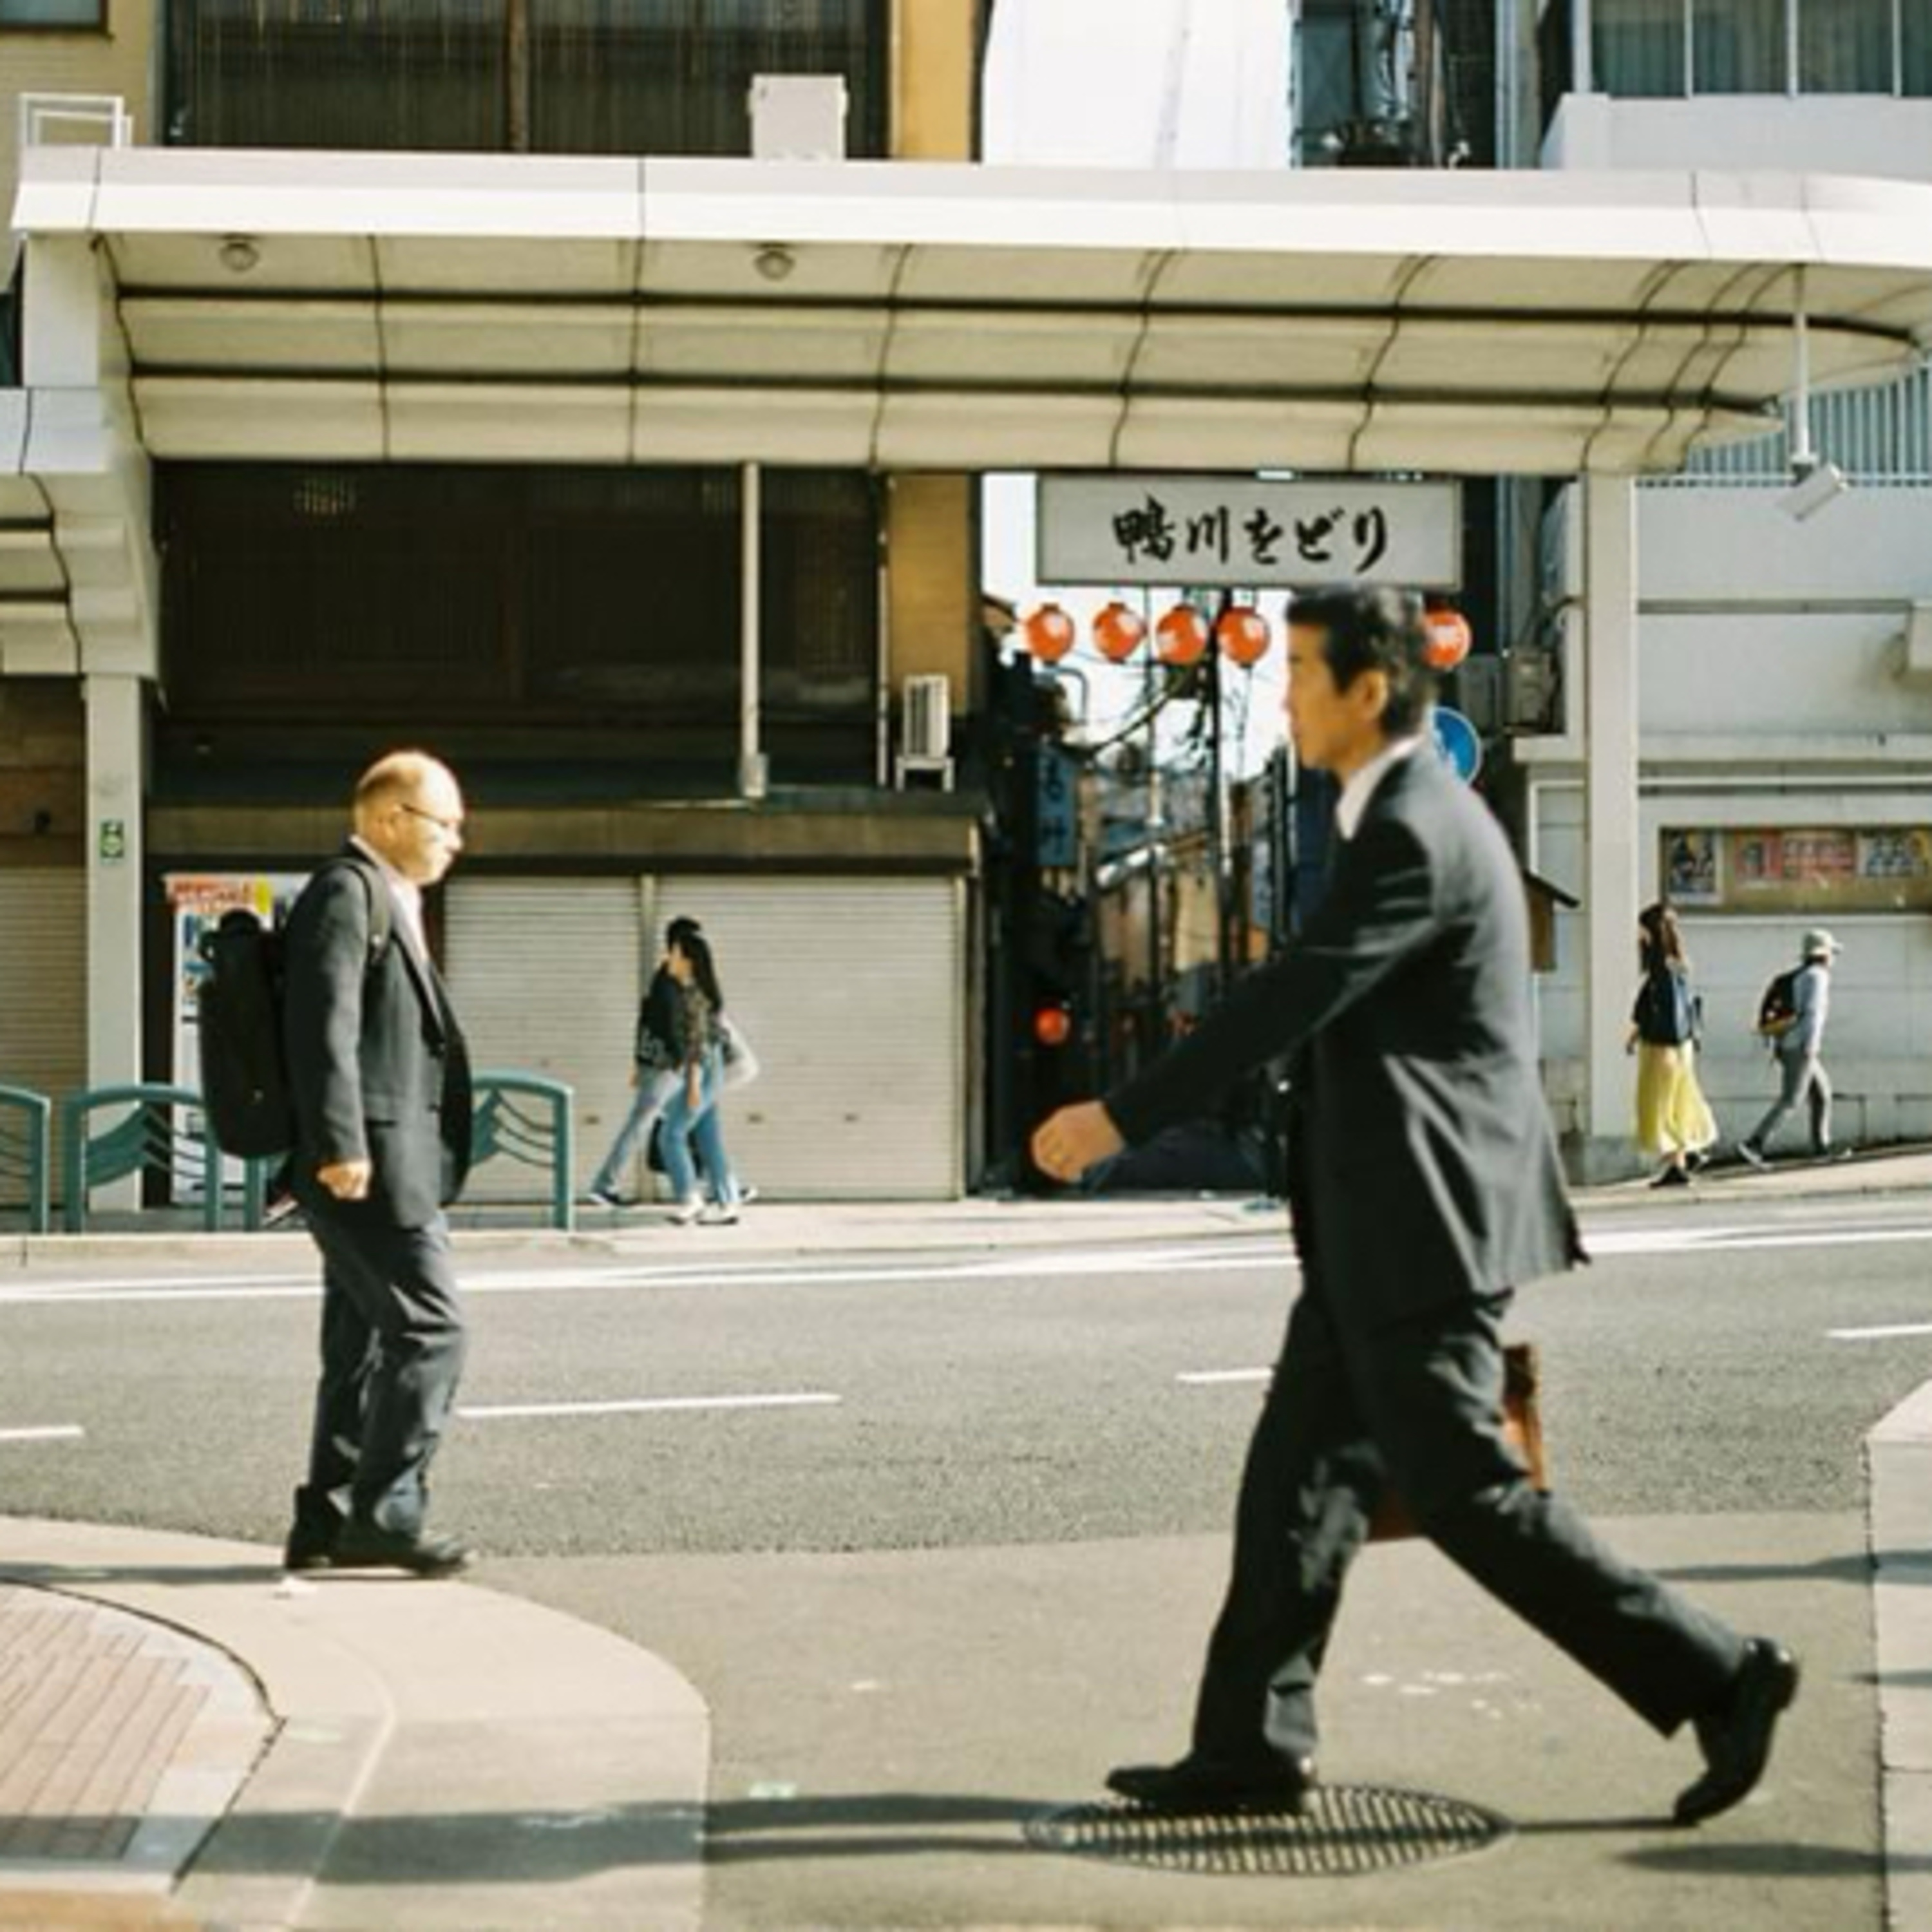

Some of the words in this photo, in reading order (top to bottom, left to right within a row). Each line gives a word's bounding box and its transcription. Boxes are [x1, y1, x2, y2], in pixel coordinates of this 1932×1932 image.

[1112, 495, 1387, 573] 鴨川をどり
